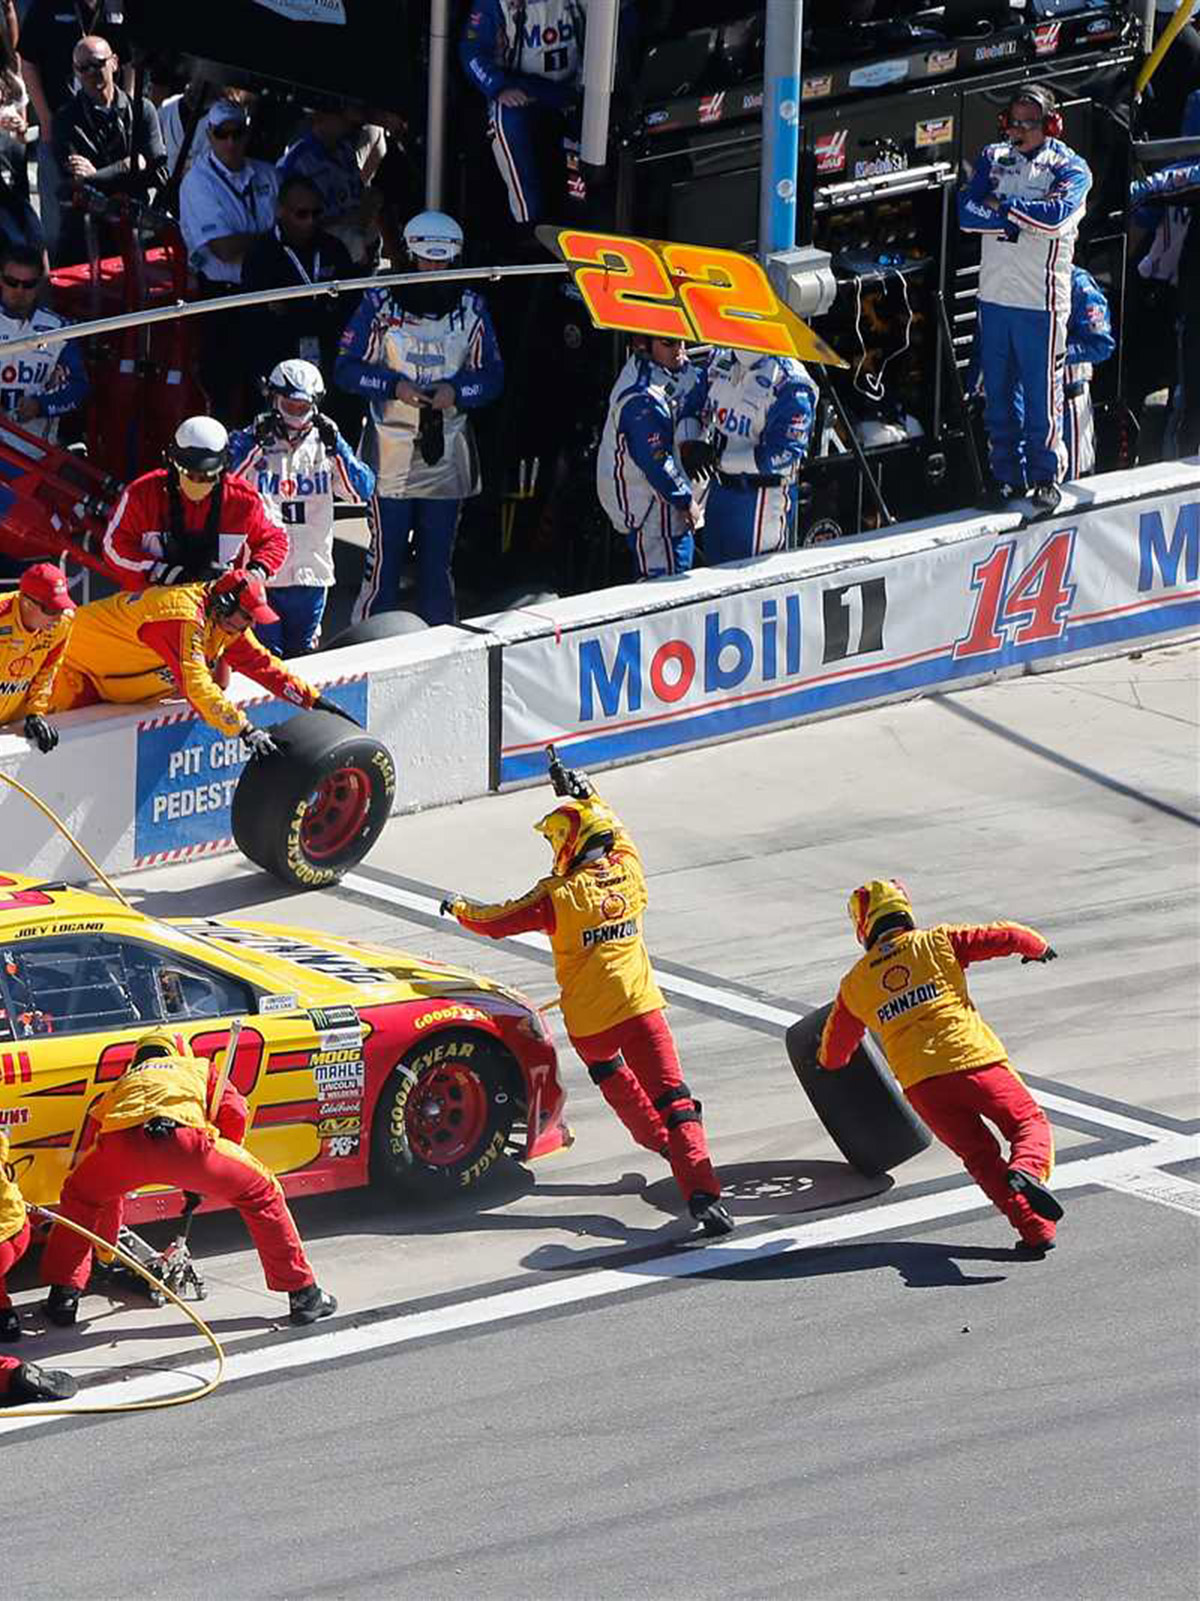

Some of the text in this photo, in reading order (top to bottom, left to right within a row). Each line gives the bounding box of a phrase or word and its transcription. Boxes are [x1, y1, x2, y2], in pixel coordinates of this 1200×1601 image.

[523, 19, 573, 48] Mob
[559, 230, 799, 358] 22
[716, 407, 751, 436] obil
[257, 471, 328, 496] Mobil
[953, 529, 1076, 660] 14
[579, 596, 799, 721] Mobil
[169, 739, 253, 778] PIT CRE
[372, 750, 396, 796] EAGLE
[153, 778, 240, 823] PEDEST
[288, 800, 335, 885] GOODYEAR
[15, 922, 104, 938] JOEY LOGANO
[582, 919, 638, 946] PENNZO
[877, 984, 939, 1026] PENNZOIL
[310, 1050, 362, 1066] MOOG
[315, 1063, 363, 1081] MAHLE
[320, 1080, 357, 1092] LINCOLN
[390, 1043, 475, 1136] GOODYEAR
[320, 1103, 361, 1115] Edelbrock
[460, 1130, 505, 1186] EAGLE
